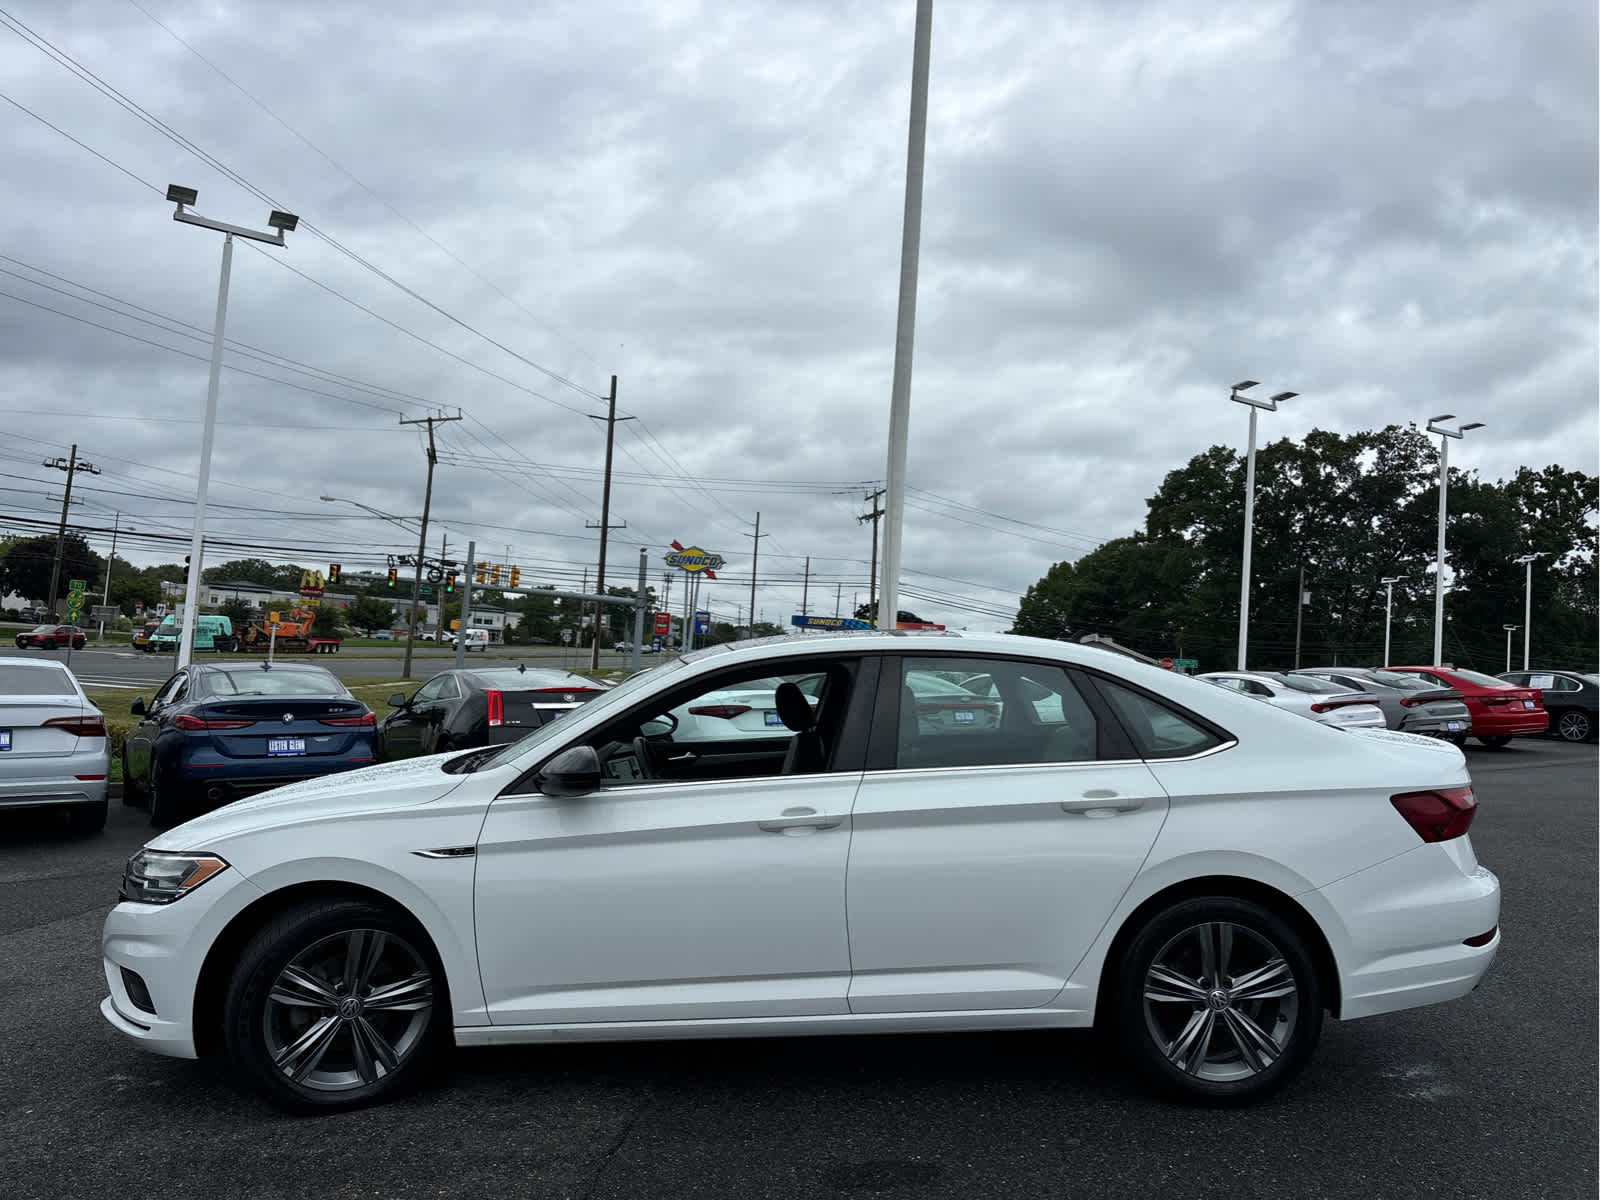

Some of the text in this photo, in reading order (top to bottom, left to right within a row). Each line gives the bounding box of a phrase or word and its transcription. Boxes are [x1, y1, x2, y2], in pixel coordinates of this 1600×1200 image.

[670, 555, 717, 566] SUNOCO
[807, 617, 843, 626] SUNOCO
[269, 740, 305, 751] LESTER GLENN
